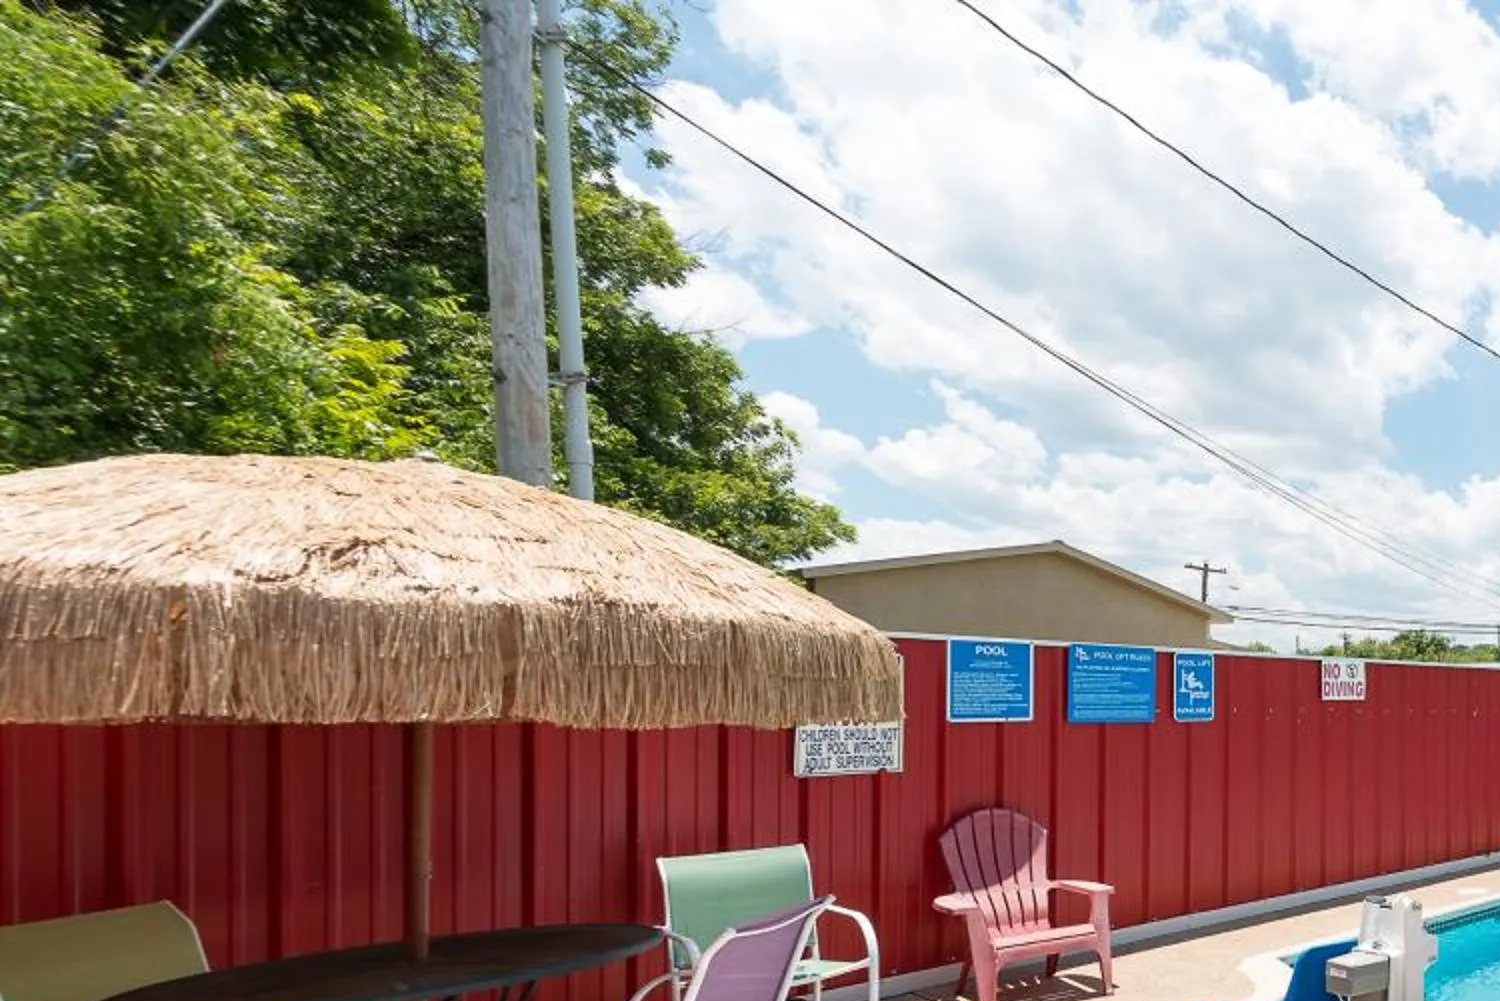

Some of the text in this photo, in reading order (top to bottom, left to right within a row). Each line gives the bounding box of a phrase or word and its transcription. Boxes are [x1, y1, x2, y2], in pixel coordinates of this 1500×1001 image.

[975, 645, 1008, 656] POOL
[1323, 663, 1341, 679] NO
[1324, 681, 1364, 697] DIVING
[800, 727, 898, 742] CHILDREN SHOULD NOT
[805, 741, 893, 756] USE POOL WITHOUT
[805, 755, 894, 770] ADULT SUPERVISION
